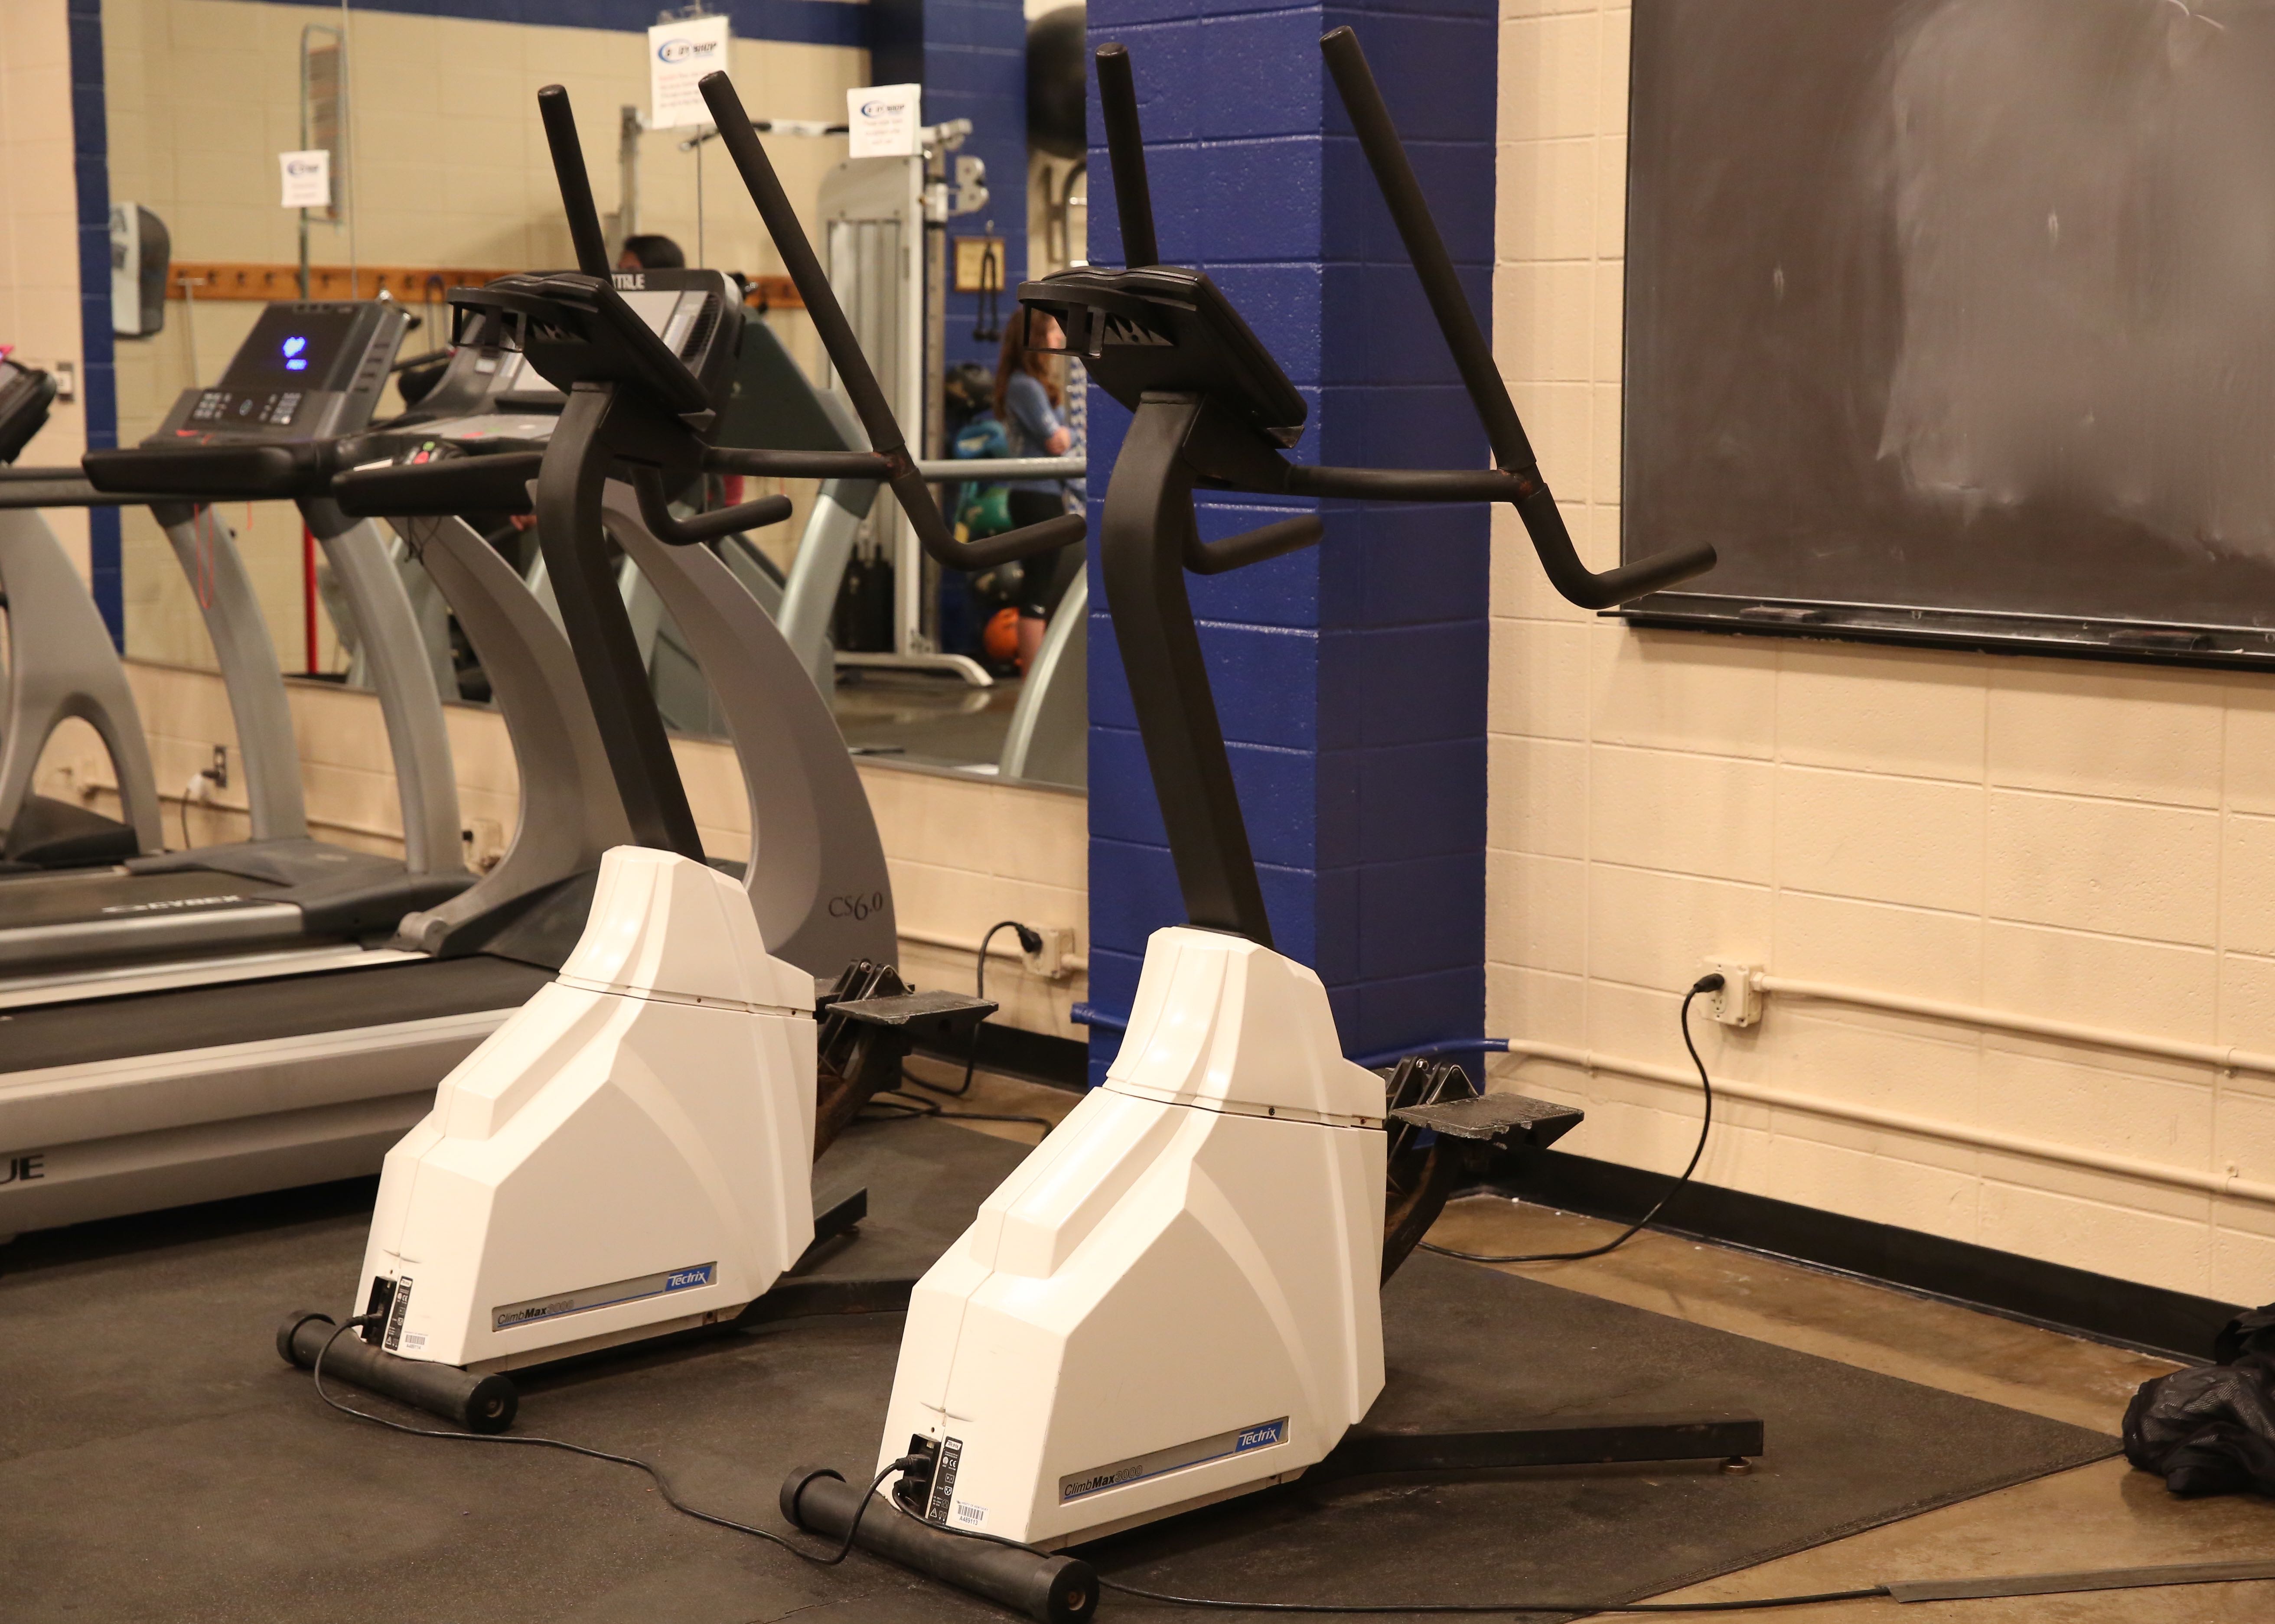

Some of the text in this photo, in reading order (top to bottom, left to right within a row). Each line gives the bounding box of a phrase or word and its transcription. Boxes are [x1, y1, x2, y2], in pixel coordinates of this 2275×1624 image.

[828, 891, 883, 921] CS6.0
[668, 1271, 707, 1286] Tectrix
[1239, 1428, 1278, 1446] Tectrix
[959, 1516, 978, 1525] A489113
